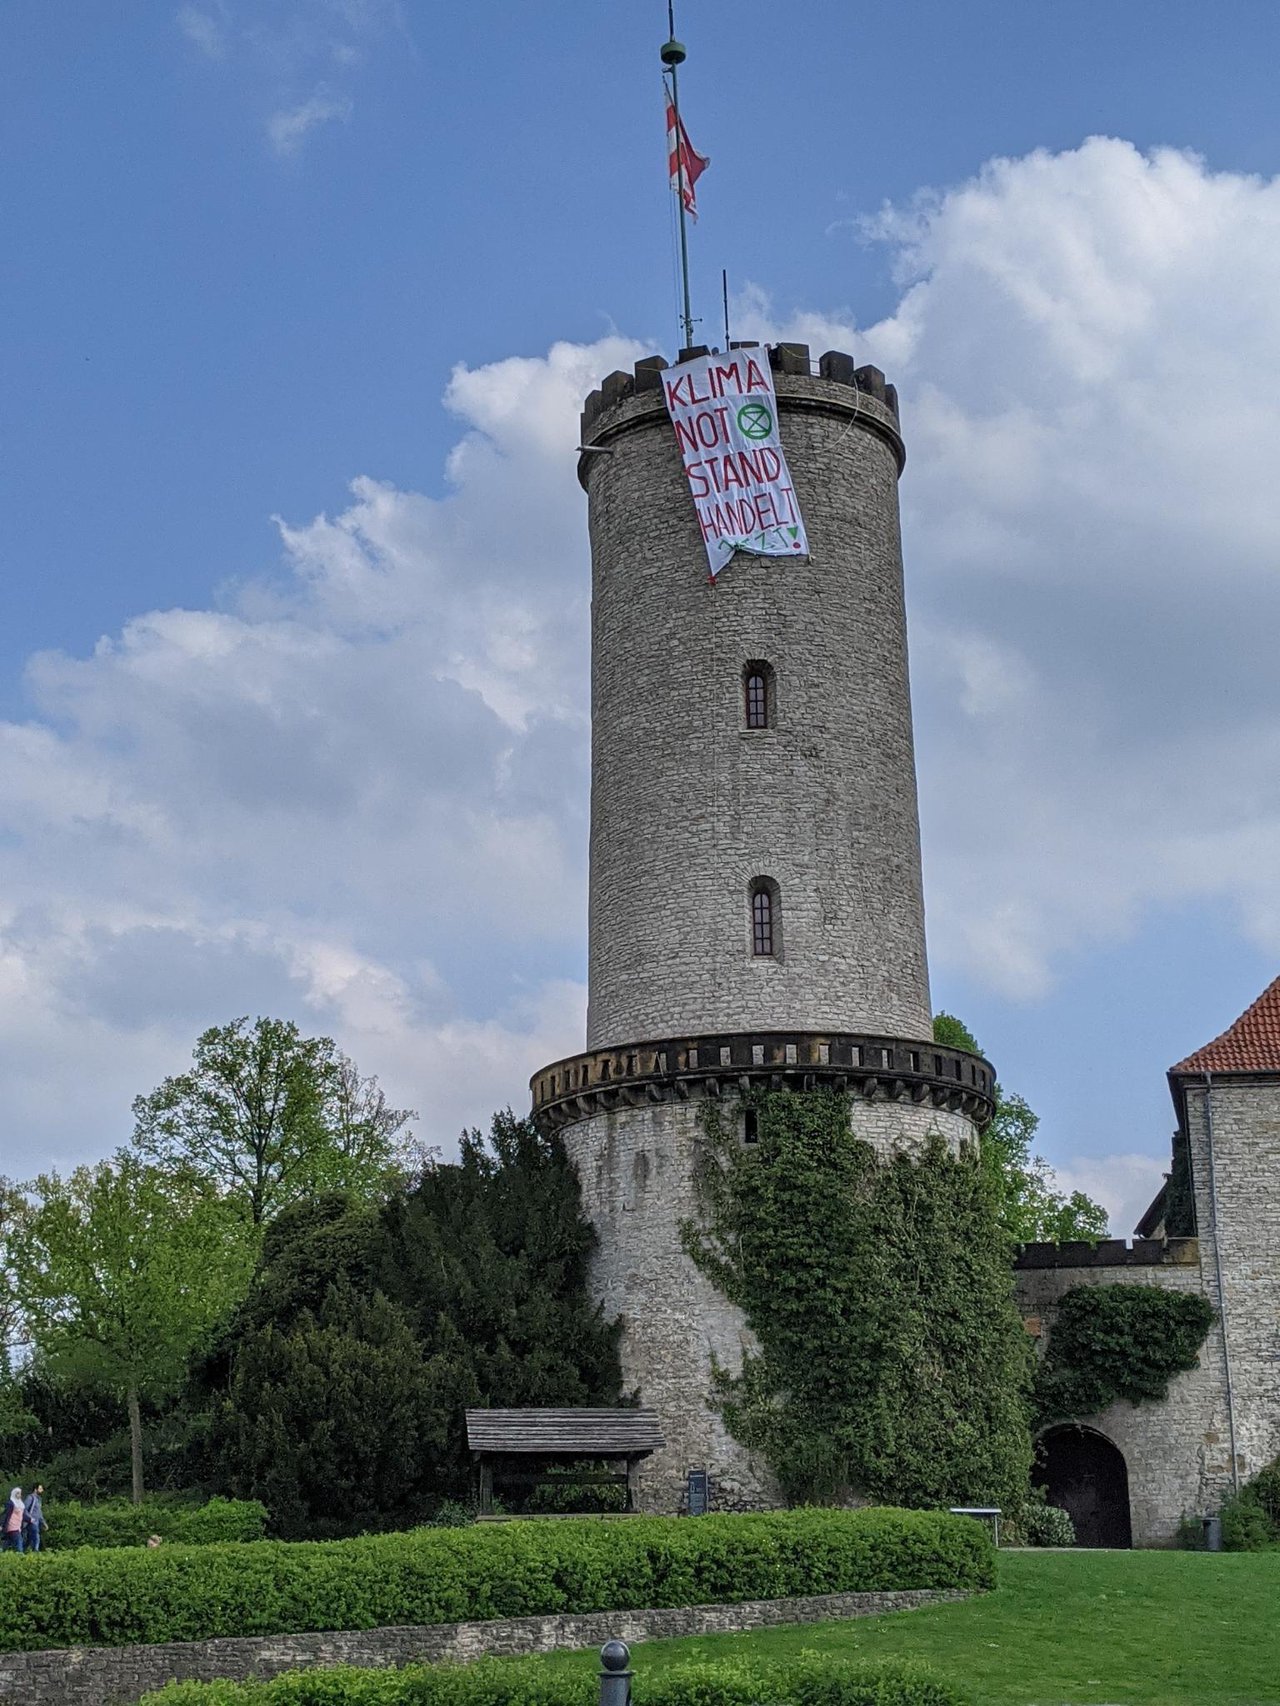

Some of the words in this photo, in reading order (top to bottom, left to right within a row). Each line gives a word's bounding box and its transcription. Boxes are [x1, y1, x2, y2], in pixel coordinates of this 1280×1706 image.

[666, 359, 770, 411] KLIMA
[674, 406, 731, 454] NOT
[685, 447, 781, 498] STAND
[697, 487, 798, 542] HANDELT
